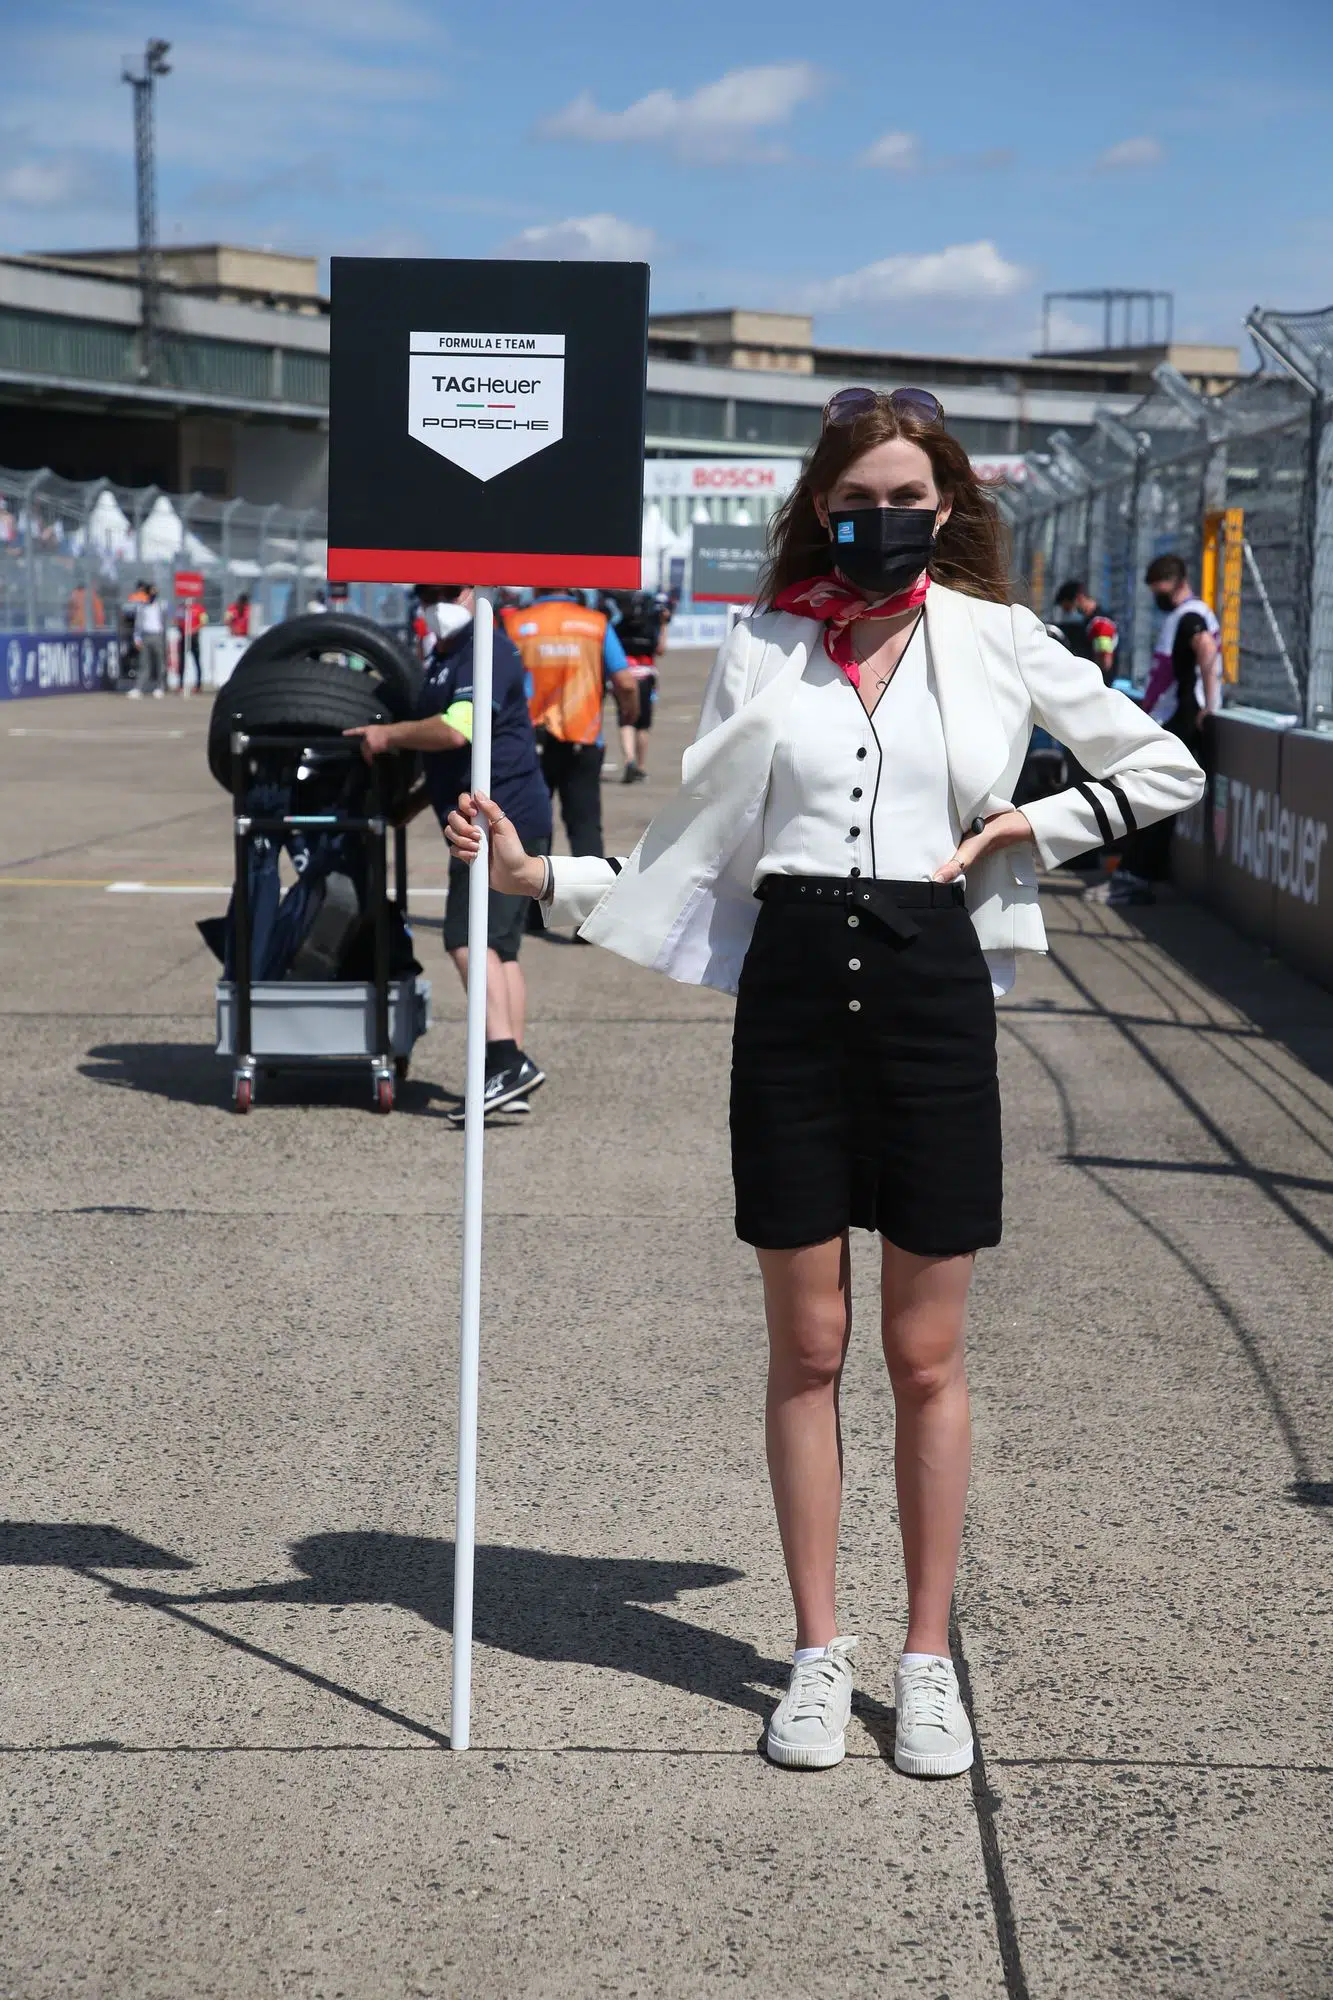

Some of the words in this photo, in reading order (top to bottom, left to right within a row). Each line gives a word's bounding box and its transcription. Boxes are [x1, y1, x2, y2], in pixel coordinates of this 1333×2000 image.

[439, 337, 492, 349] FORMULA
[495, 338, 502, 349] E
[504, 338, 536, 350] TEAM
[422, 417, 549, 431] PORSCHE
[693, 467, 776, 489] BOSCH
